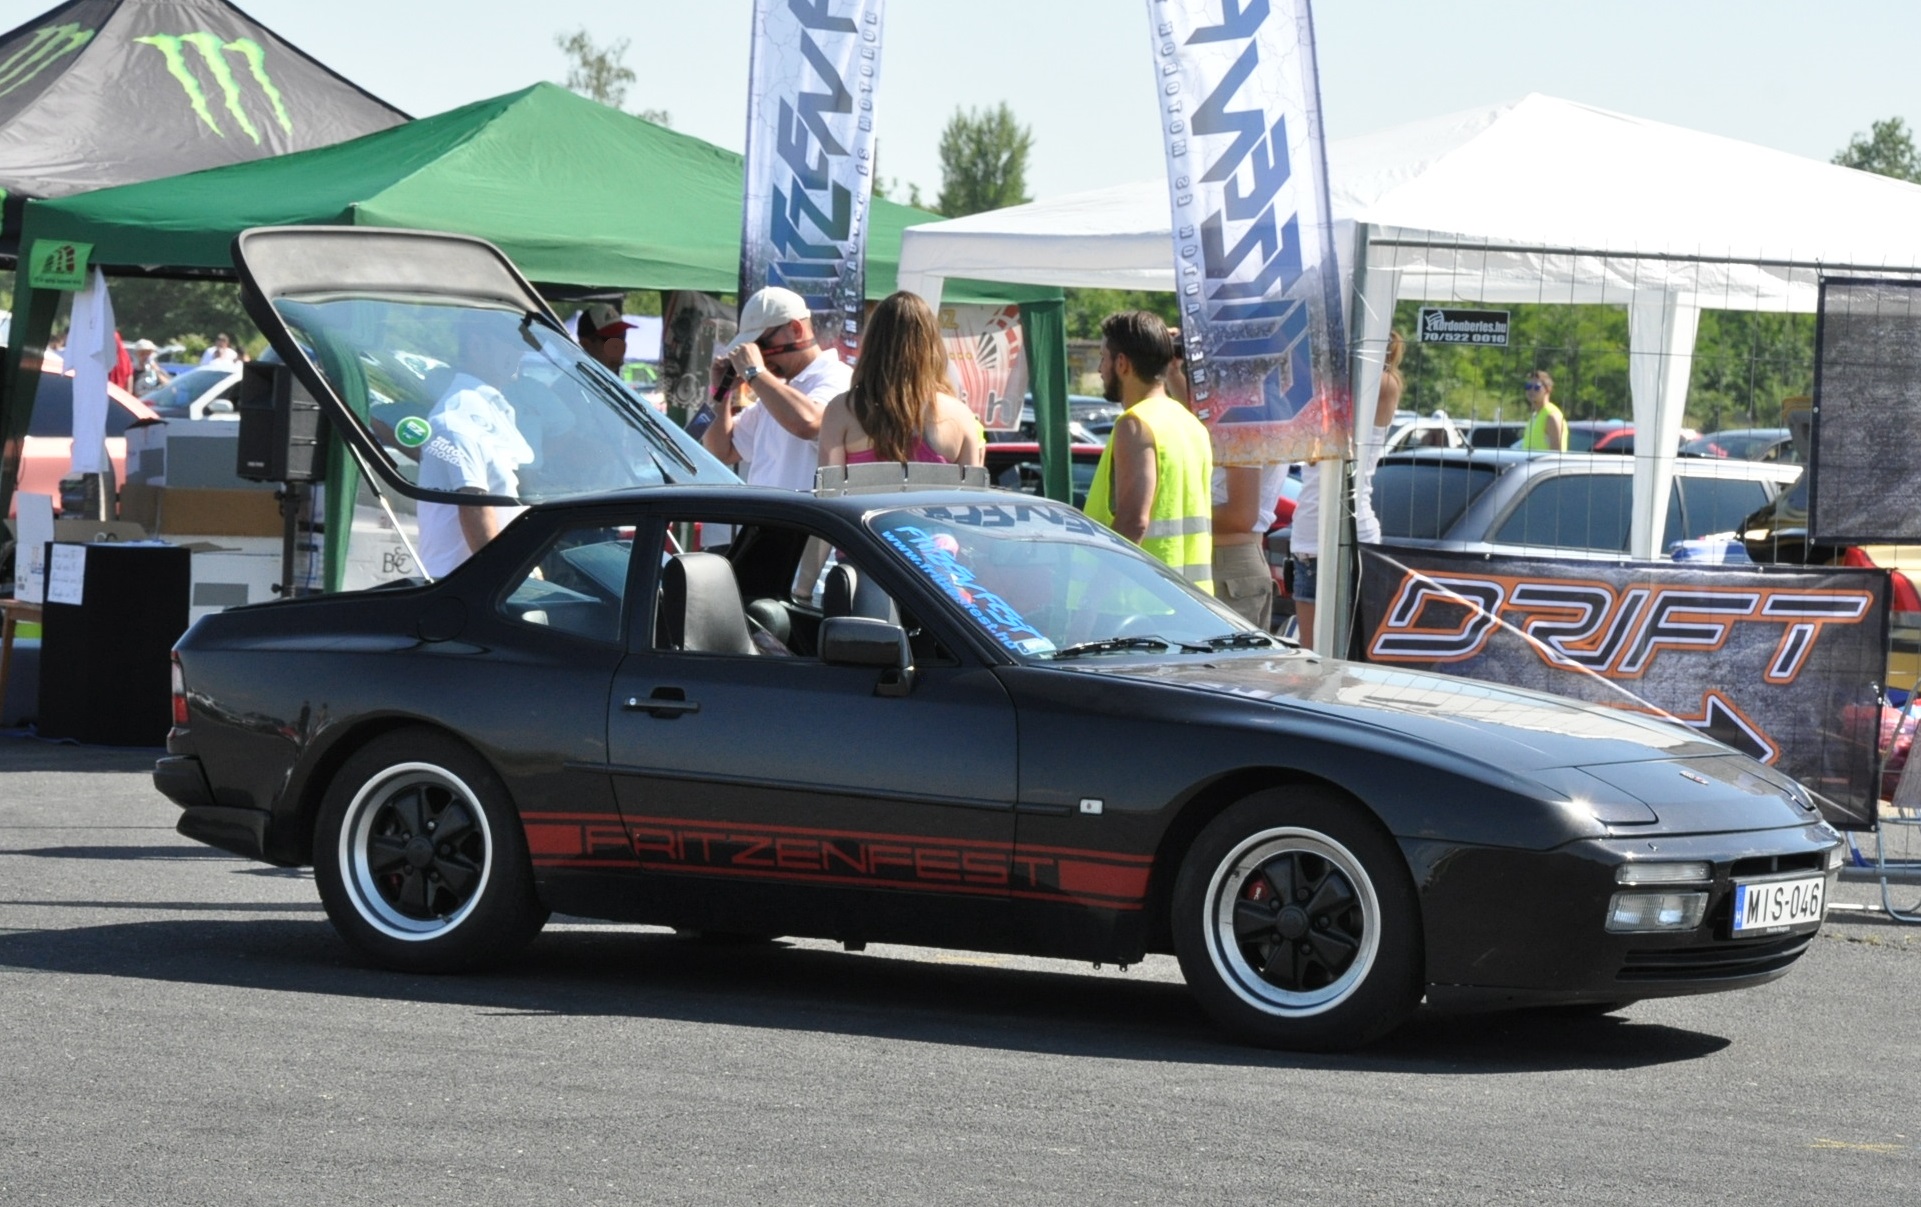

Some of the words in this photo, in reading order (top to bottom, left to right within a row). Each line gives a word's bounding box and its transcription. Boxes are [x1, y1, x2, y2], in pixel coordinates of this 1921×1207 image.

[881, 531, 1018, 650] www.fritzenfest.hu
[1367, 569, 1875, 684] DRIFT
[584, 824, 1055, 887] FRITZENFEST
[1746, 883, 1820, 924] MIS-046
